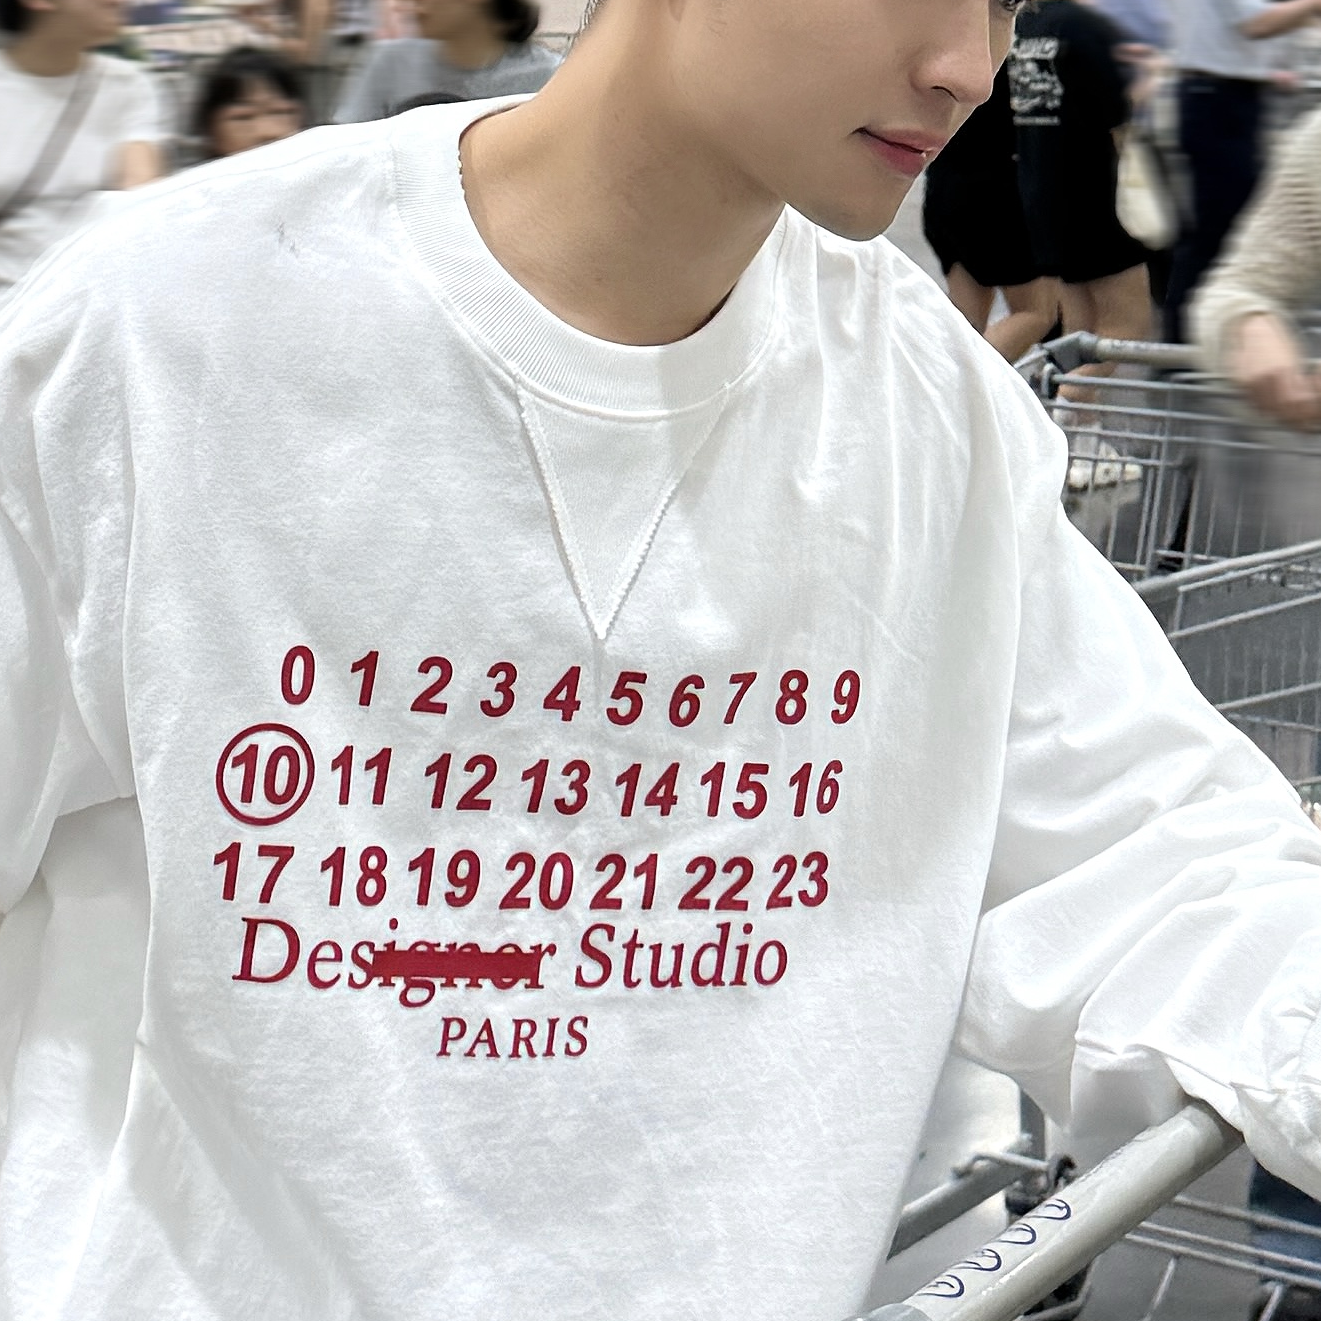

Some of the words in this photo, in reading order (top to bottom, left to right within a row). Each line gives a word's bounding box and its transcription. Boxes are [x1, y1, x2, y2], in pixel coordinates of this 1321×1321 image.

[281, 646, 314, 705] 0
[352, 651, 378, 706] 1
[412, 657, 452, 714] 2
[481, 662, 516, 716] 3
[544, 666, 580, 721] 4
[607, 671, 646, 725] 5
[670, 675, 704, 727] 6
[725, 672, 756, 723] 7
[776, 670, 807, 724] 8
[831, 670, 859, 723] 9
[232, 744, 300, 805] 10
[332, 746, 391, 805] 11
[427, 753, 496, 810] 12
[523, 759, 590, 814] 13
[617, 762, 679, 817] 14
[702, 762, 768, 819] 15
[791, 761, 842, 817] 16
[215, 842, 294, 903] 17
[322, 846, 387, 906] 18
[409, 847, 480, 907] 19
[500, 852, 573, 910] 20
[591, 853, 657, 909] 21
[679, 856, 753, 911] 22
[767, 852, 828, 909] 23
[576, 922, 787, 989] Studio
[439, 1016, 587, 1058] PARIS
